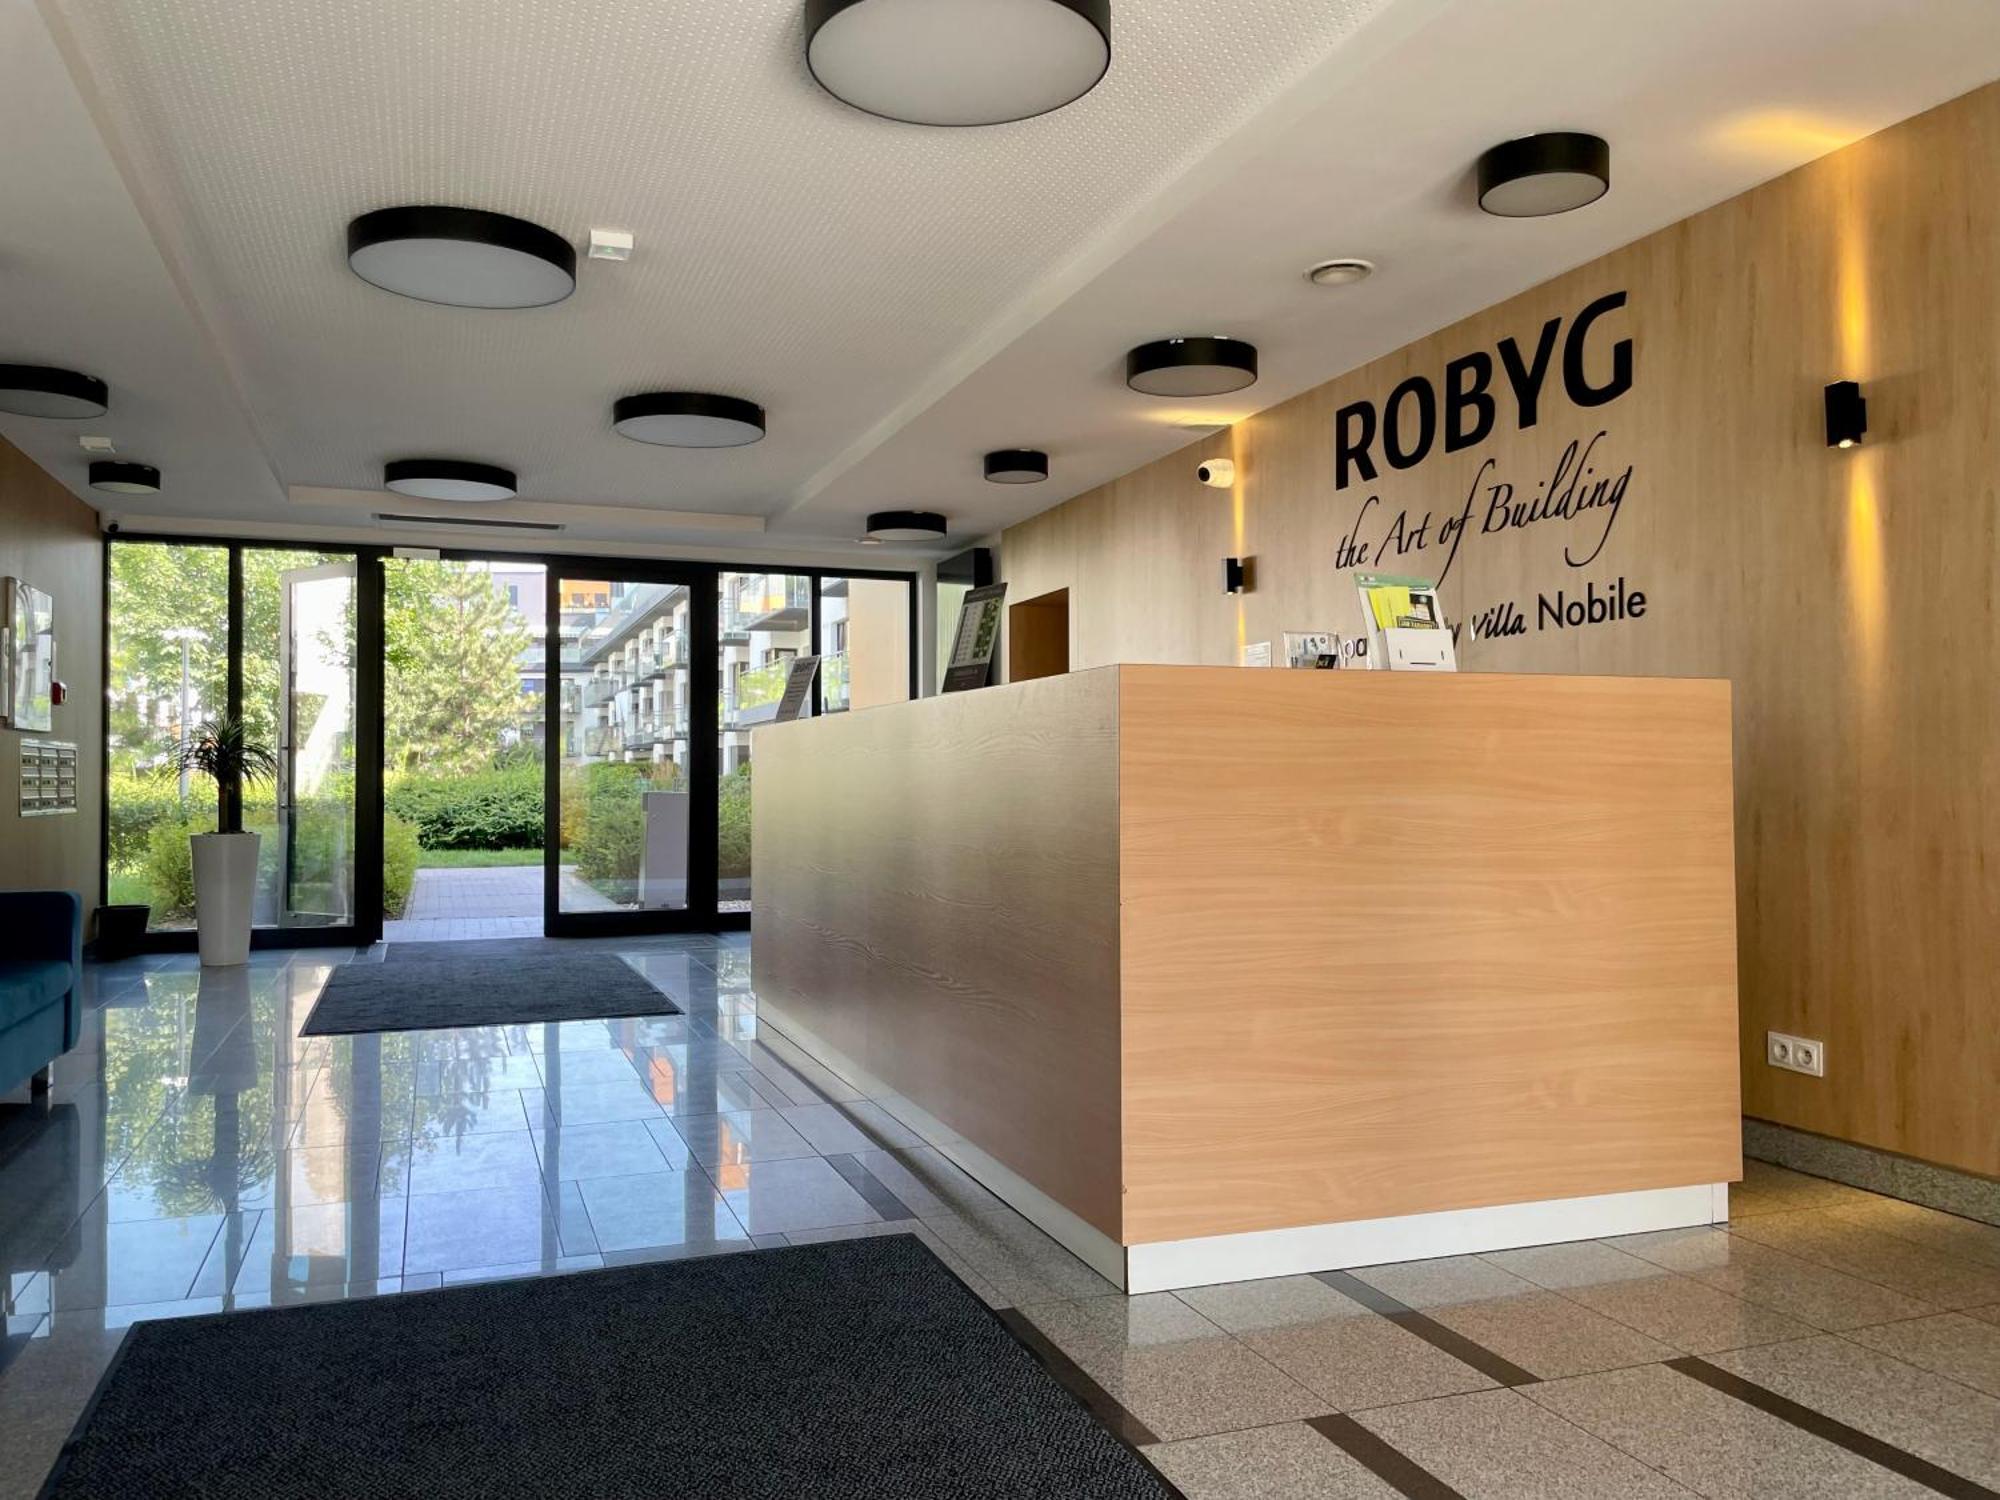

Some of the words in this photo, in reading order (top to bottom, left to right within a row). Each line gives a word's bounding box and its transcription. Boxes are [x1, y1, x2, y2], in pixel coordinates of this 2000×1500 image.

[1335, 290, 1633, 491] ROBYG
[1336, 495, 1379, 570] the
[1375, 510, 1432, 567] Art
[1438, 458, 1496, 590] of
[1481, 430, 1633, 568] Building
[1537, 576, 1647, 631] Nobile
